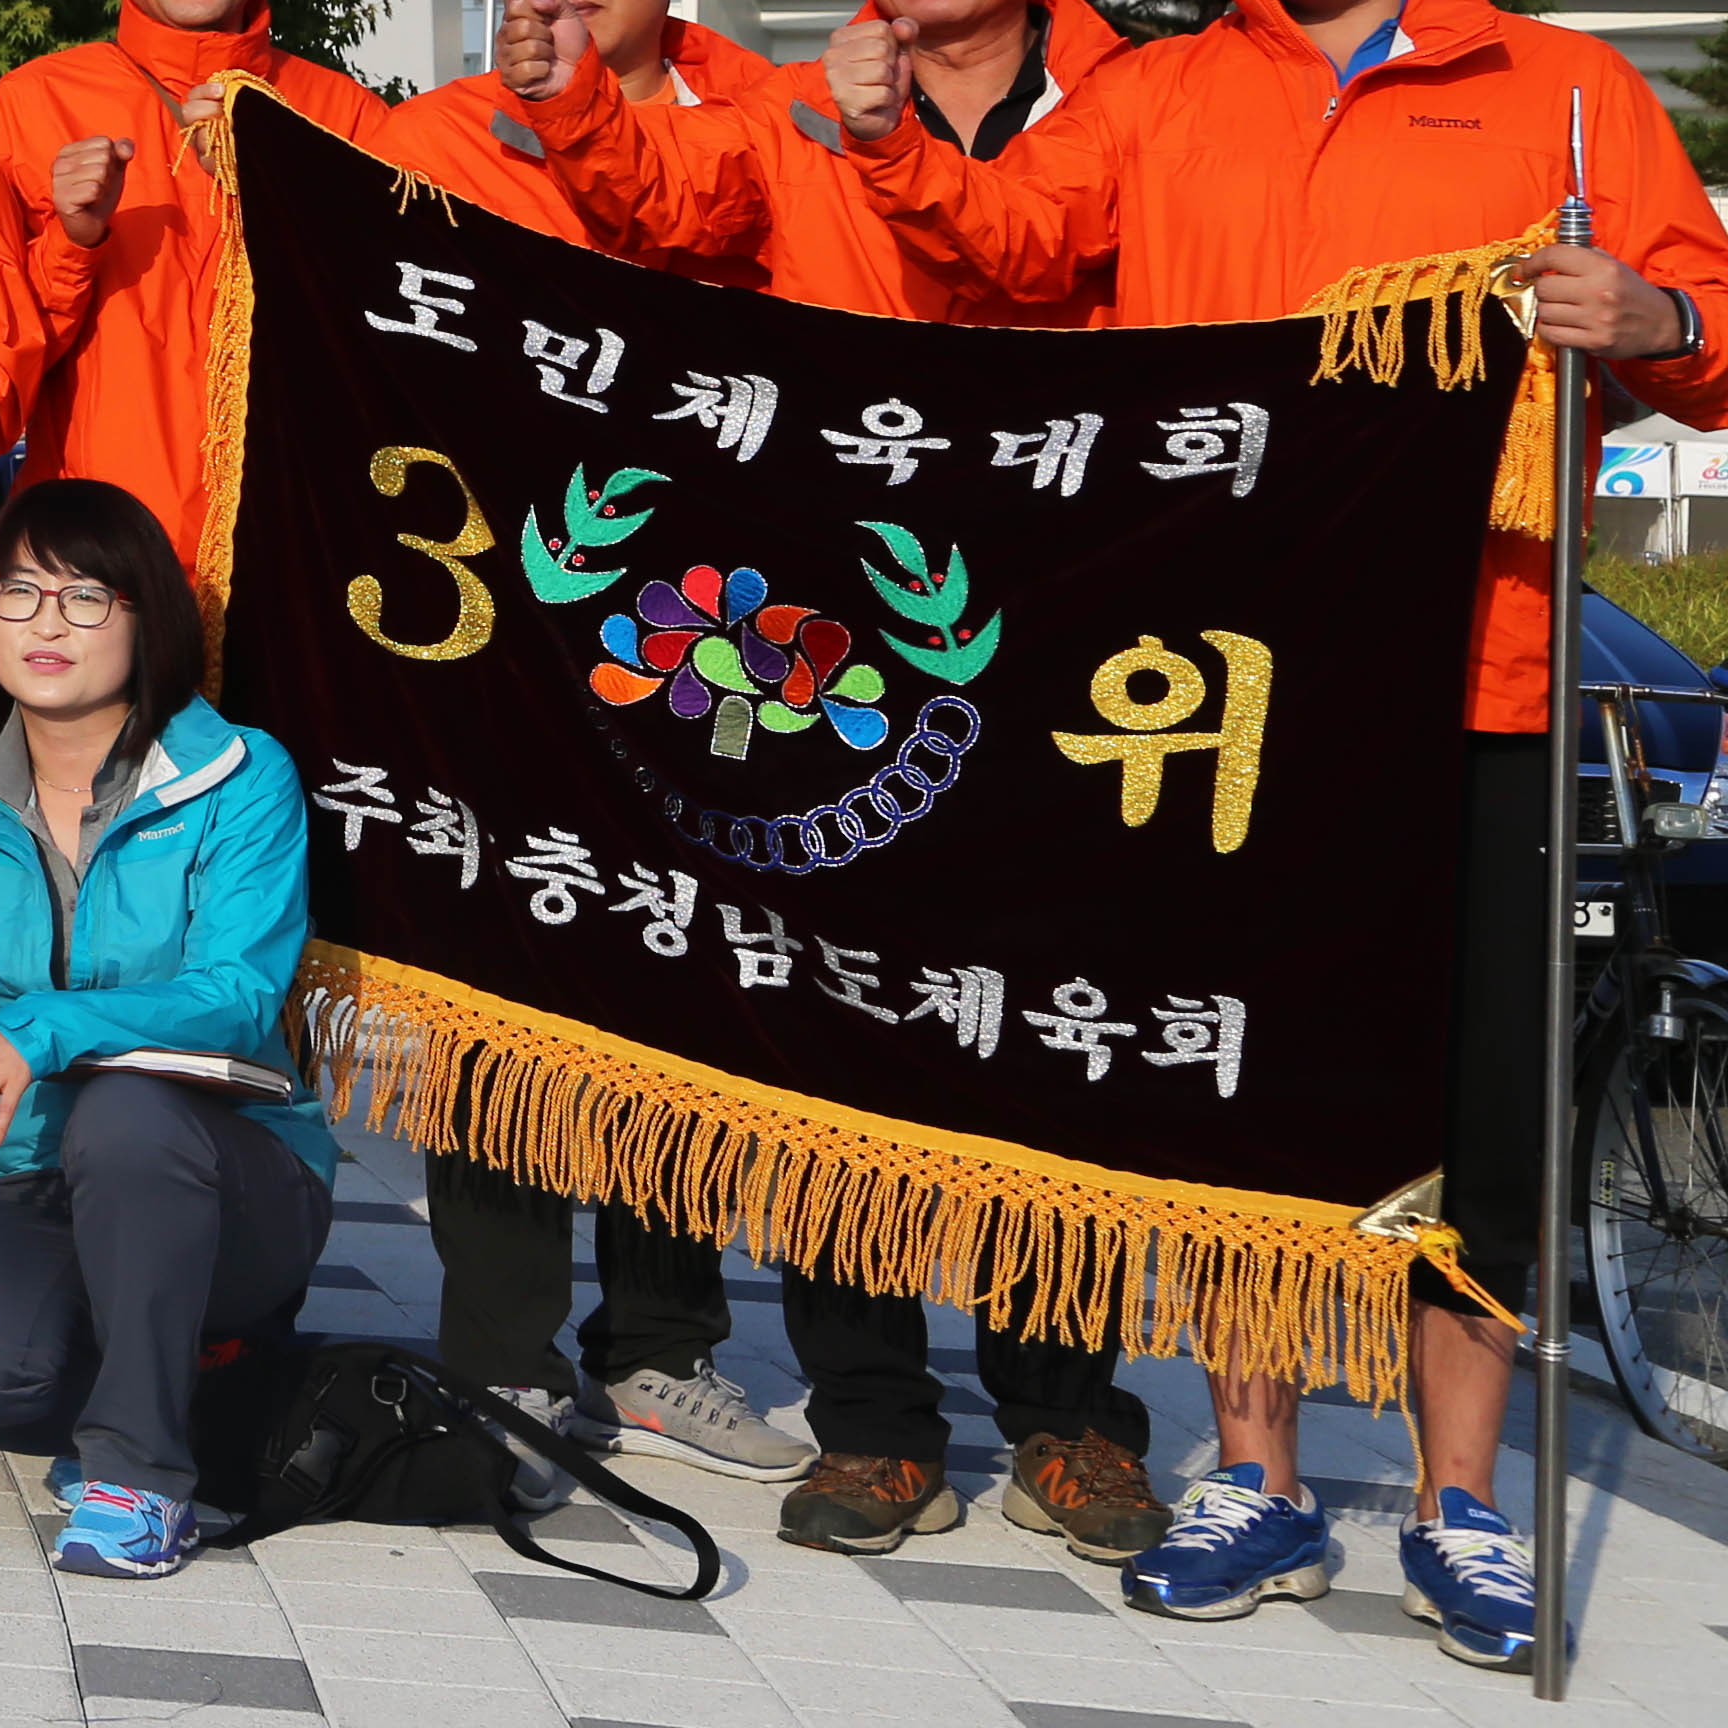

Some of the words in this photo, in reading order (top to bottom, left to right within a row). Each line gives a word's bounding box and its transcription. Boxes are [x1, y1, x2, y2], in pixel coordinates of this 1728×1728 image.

[1407, 114, 1483, 131] Marmot
[364, 261, 1271, 499] 도민체육대회
[136, 821, 186, 844] Marmot
[504, 825, 1247, 1099] 충청남도체육회
